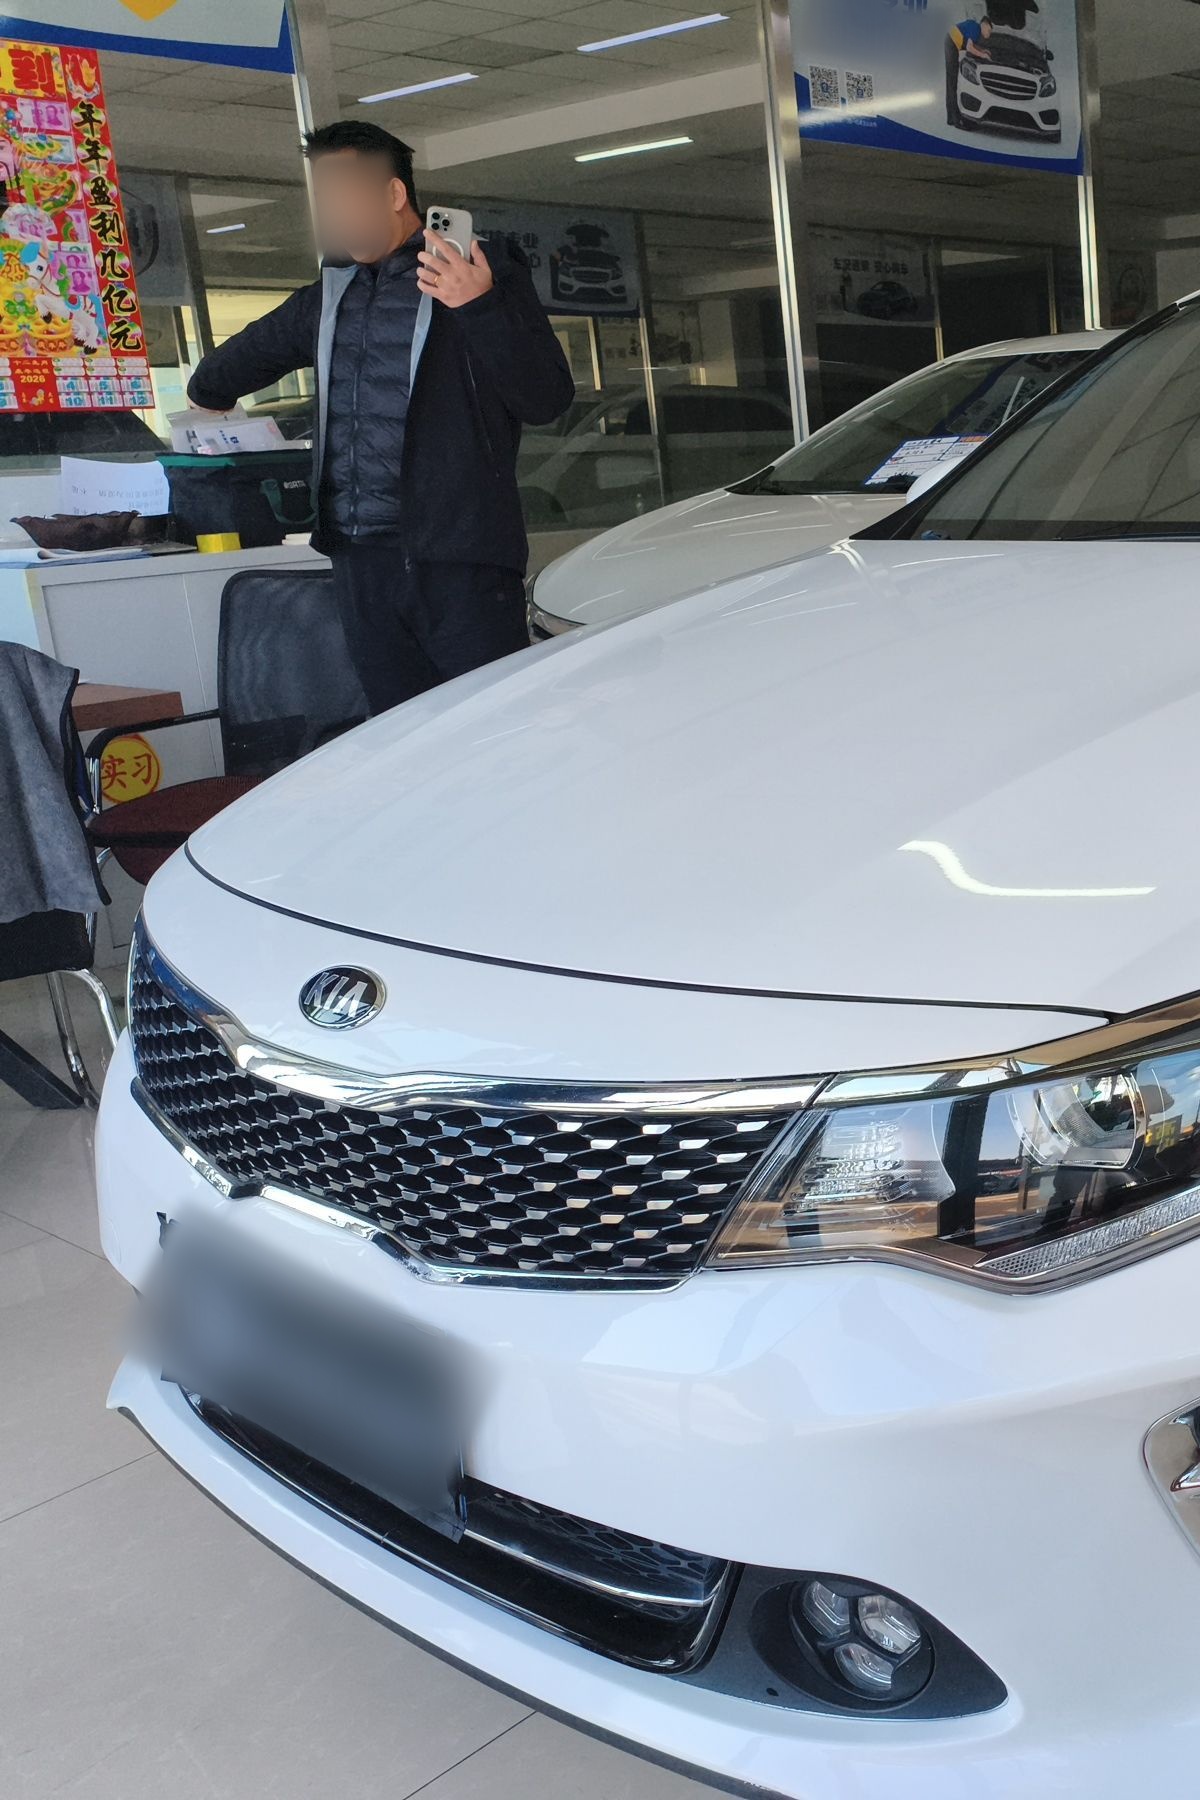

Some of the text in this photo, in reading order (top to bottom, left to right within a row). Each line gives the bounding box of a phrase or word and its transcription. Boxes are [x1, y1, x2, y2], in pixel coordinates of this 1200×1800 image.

[0, 49, 56, 97] 到
[74, 101, 142, 350] 年年盈利几亿元
[20, 375, 46, 383] 2026
[101, 754, 152, 789] 实习
[303, 971, 368, 1018] KIA
